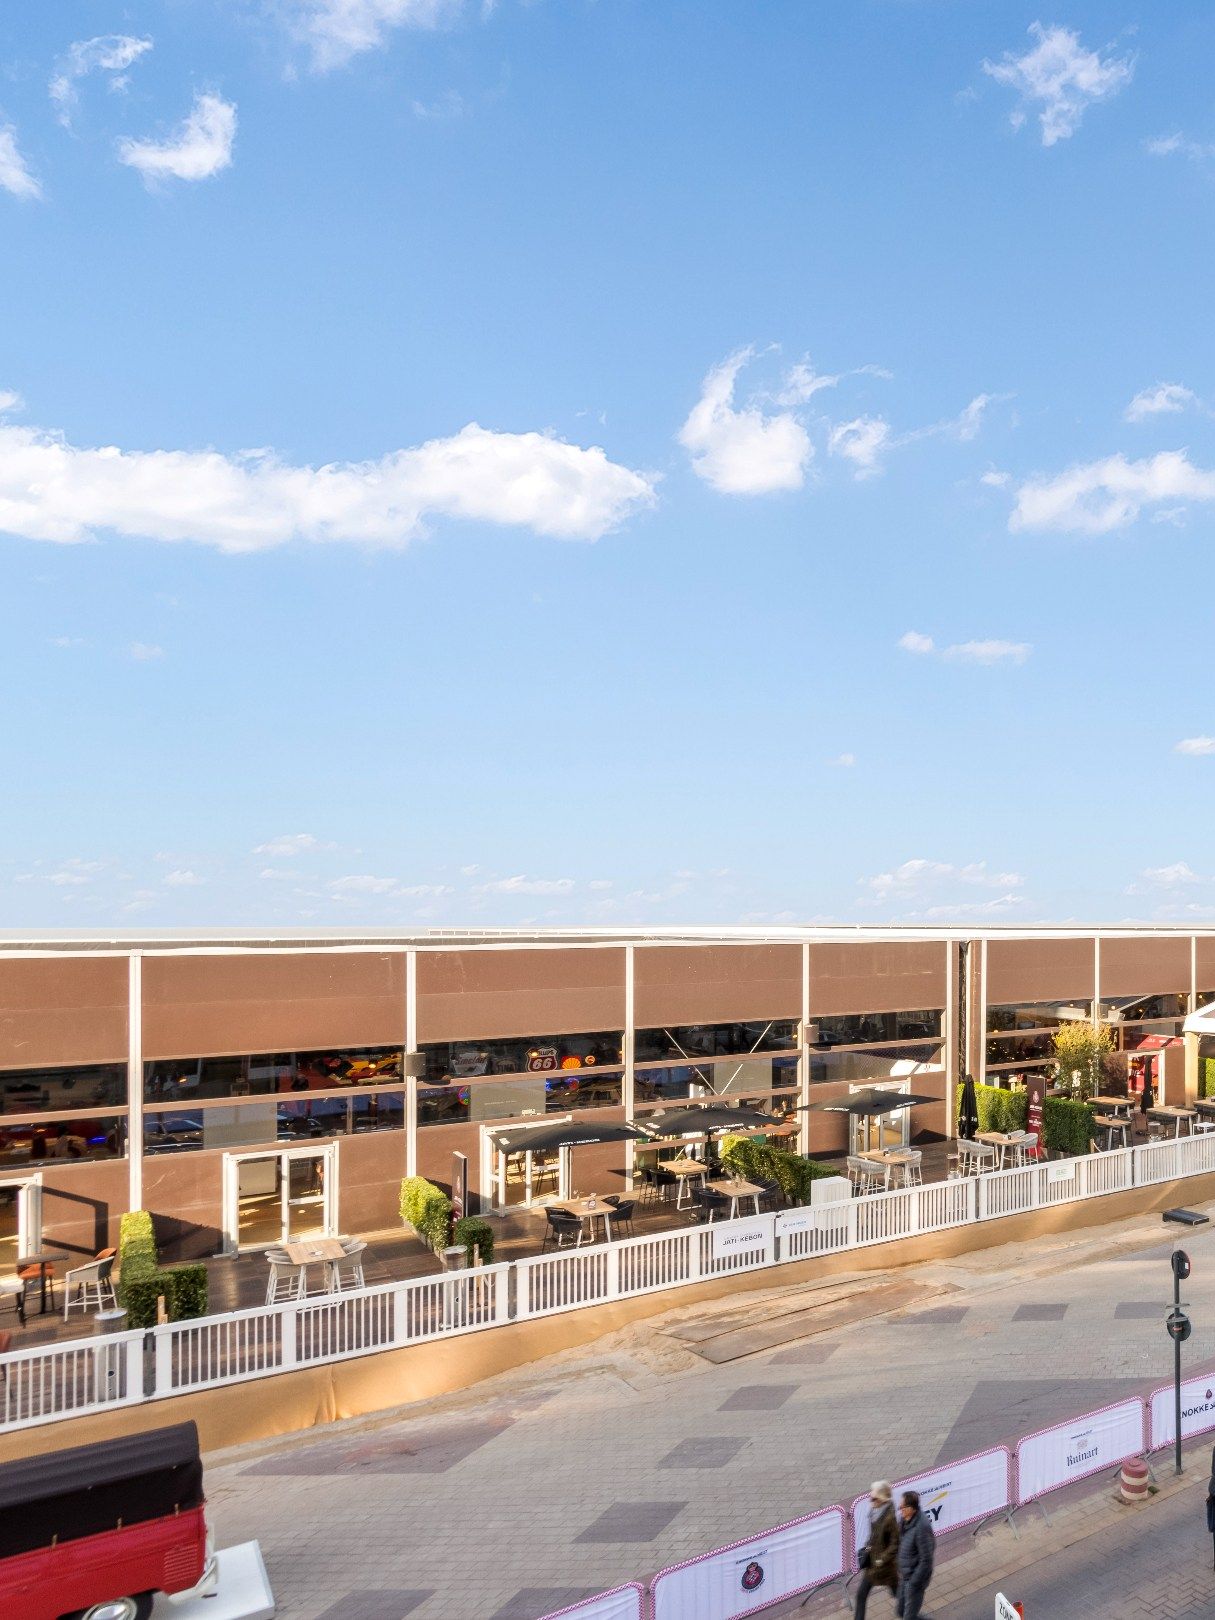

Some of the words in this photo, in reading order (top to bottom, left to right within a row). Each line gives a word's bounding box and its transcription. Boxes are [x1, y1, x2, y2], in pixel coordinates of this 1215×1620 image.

[532, 1057, 553, 1069] 66
[722, 1232, 763, 1246] JATI-KEBON
[1180, 1403, 1209, 1419] NOKKE
[1066, 1446, 1098, 1467] Ruinart
